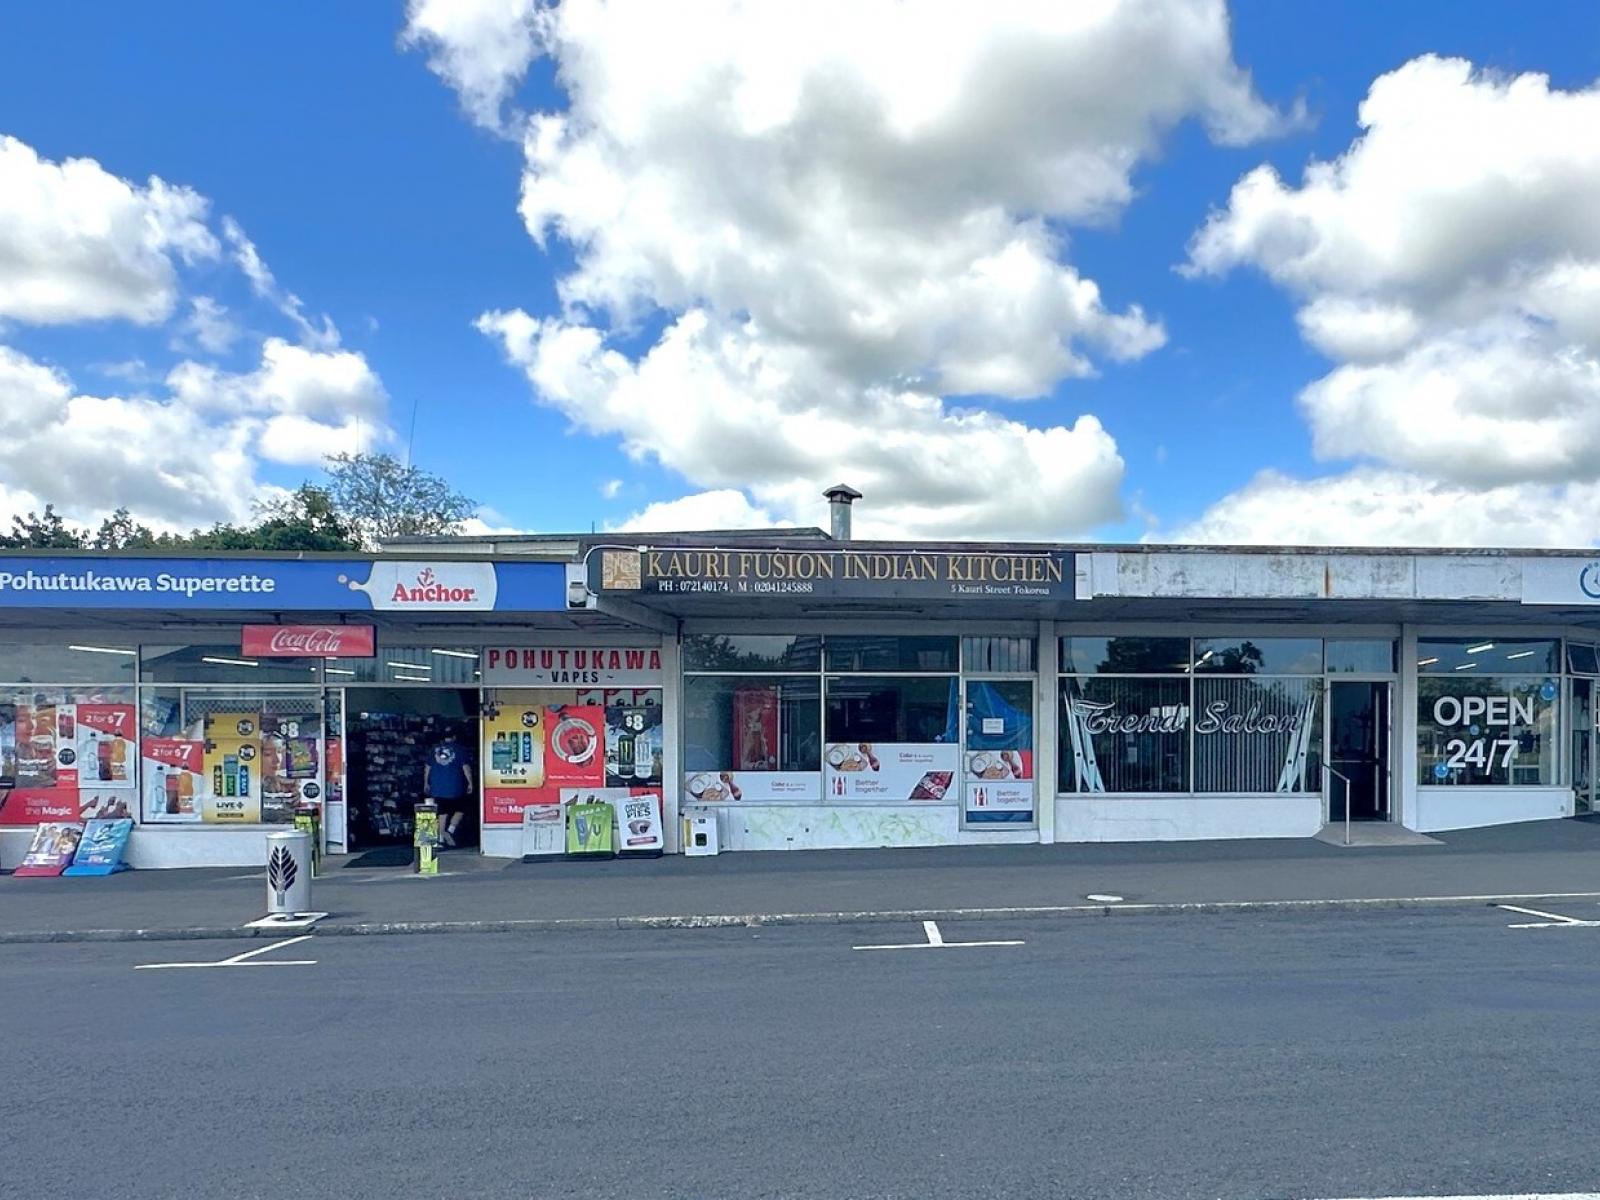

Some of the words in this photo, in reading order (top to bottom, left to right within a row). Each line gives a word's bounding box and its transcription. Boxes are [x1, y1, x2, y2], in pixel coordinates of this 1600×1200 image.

[647, 552, 732, 578] KAURI
[738, 553, 835, 579] FUSION
[842, 555, 939, 580] INDIAN
[946, 556, 1064, 583] KITCHEN
[0, 571, 151, 592] Pohutukawa
[156, 574, 275, 597] Superette
[391, 583, 476, 602] Anchor
[950, 584, 957, 593] 5
[958, 584, 983, 594] Kauri
[985, 585, 1010, 595] Street
[489, 650, 661, 670] POHUTUKAWA
[551, 671, 600, 683] VAPES
[85, 714, 92, 722] 2
[1072, 700, 1185, 735] Trend
[1195, 701, 1301, 735] Salon
[1433, 696, 1533, 726] OPEN
[626, 714, 644, 731] $8
[152, 748, 160, 756] 2
[1446, 739, 1519, 776] 24/7
[42, 806, 72, 816] Magic
